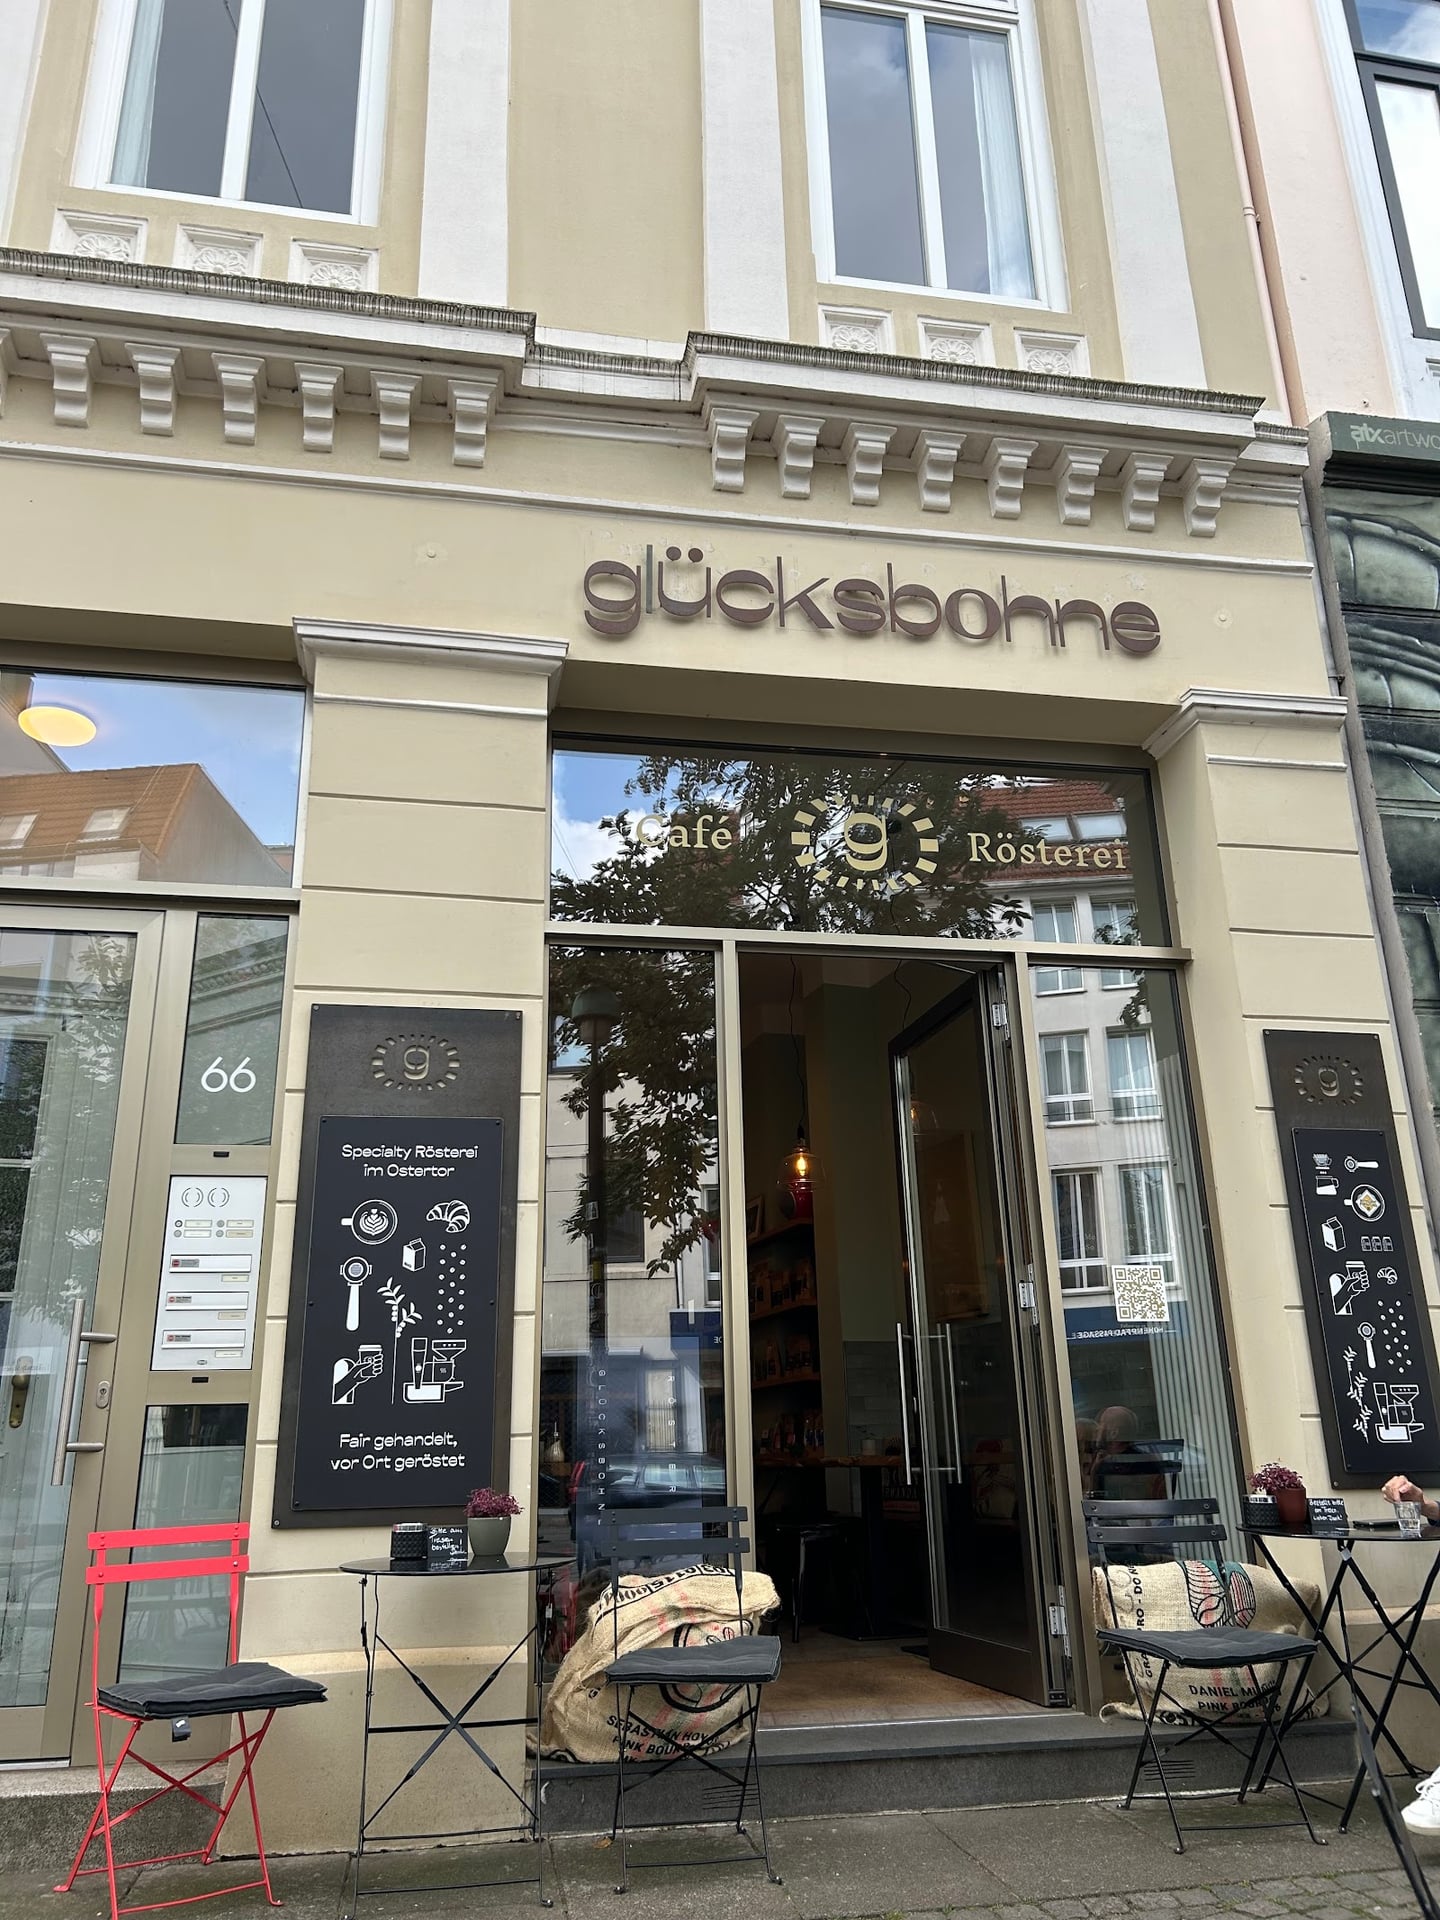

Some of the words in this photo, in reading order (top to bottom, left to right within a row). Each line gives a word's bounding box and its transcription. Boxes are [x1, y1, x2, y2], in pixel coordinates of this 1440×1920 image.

[584, 544, 1161, 655] glücksbohne
[636, 815, 733, 851] Café
[968, 831, 1126, 870] Rösterei
[201, 1056, 257, 1093] 66
[342, 1143, 413, 1161] Specialty
[414, 1144, 479, 1159] Rösterei
[363, 1163, 384, 1177] im
[387, 1163, 455, 1178] Ostertor
[339, 1433, 371, 1449] Fair
[374, 1432, 458, 1450] gehandelt,
[330, 1458, 359, 1471] vor
[362, 1455, 391, 1470] Ort
[394, 1453, 465, 1472] geröstet
[1188, 1684, 1238, 1697] DANIEL
[612, 1735, 645, 1753] PNK
